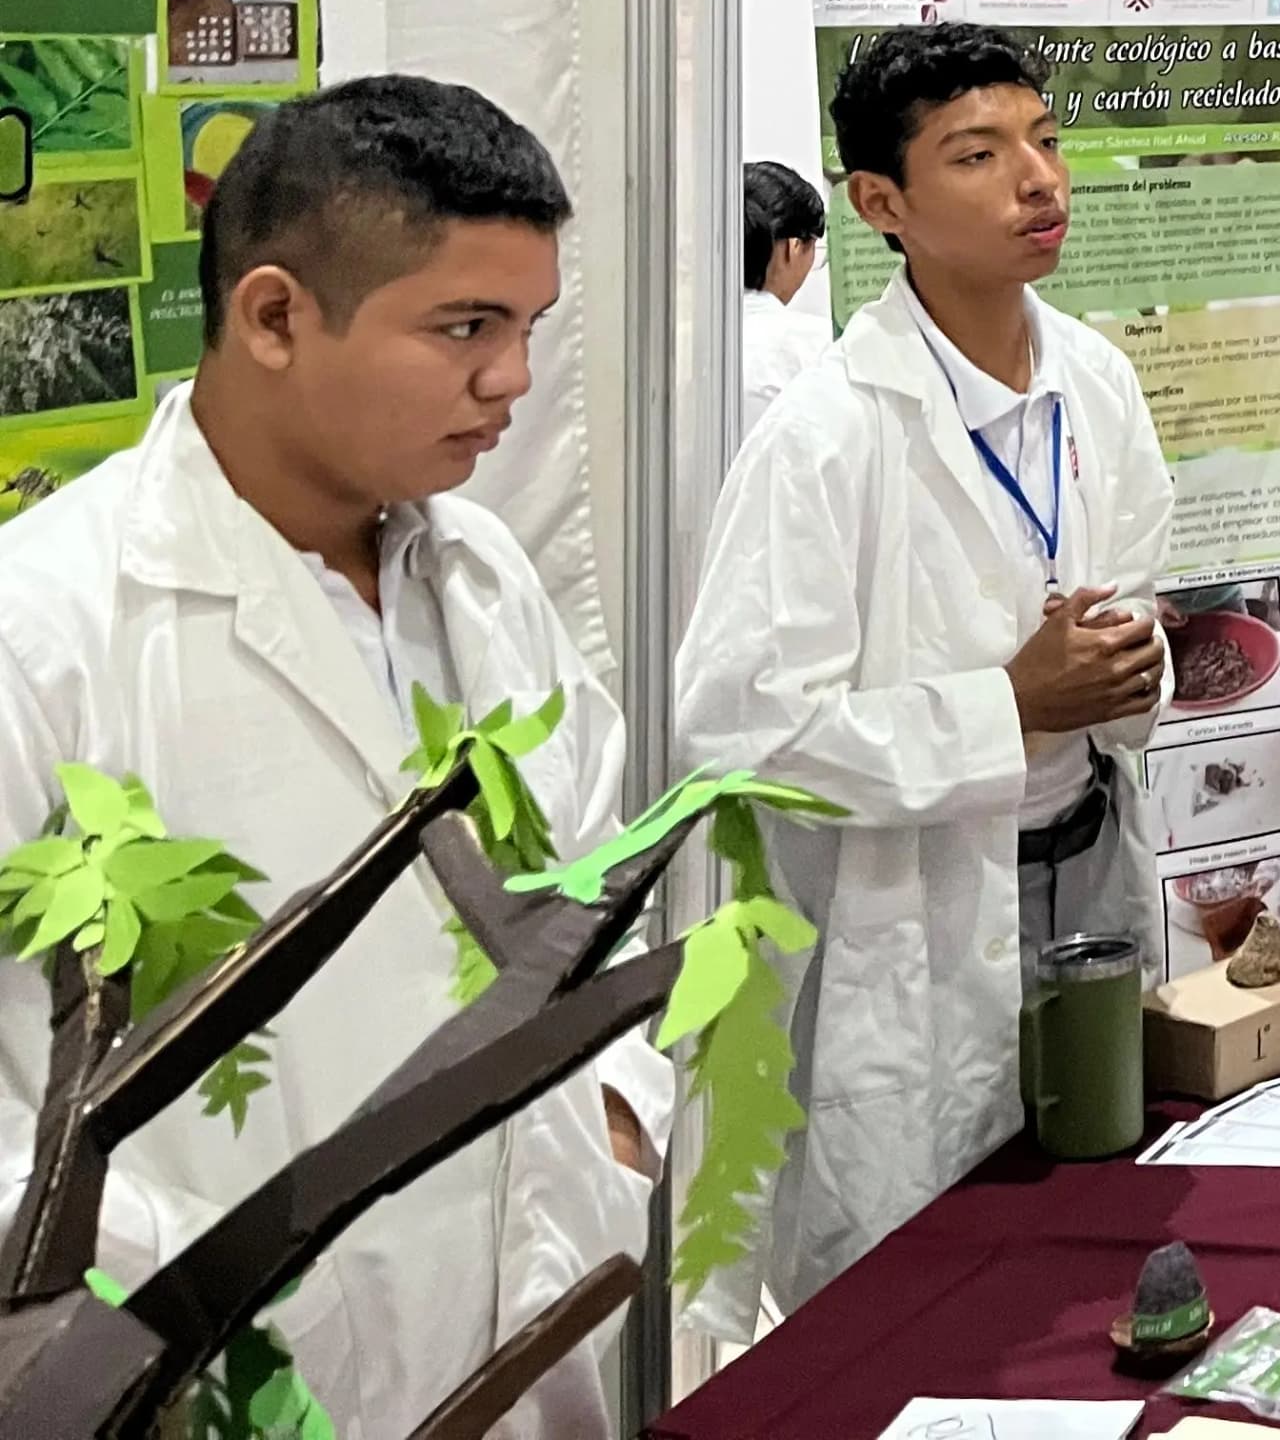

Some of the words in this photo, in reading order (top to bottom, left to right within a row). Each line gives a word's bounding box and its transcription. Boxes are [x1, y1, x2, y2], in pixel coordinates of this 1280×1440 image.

[1105, 33, 1212, 74] ecológico
[1222, 40, 1236, 61] a
[1064, 89, 1083, 126] y
[1093, 81, 1171, 110] cartón
[1071, 182, 1130, 194] anteamiento
[1132, 179, 1147, 192] del
[1149, 178, 1192, 195] problema
